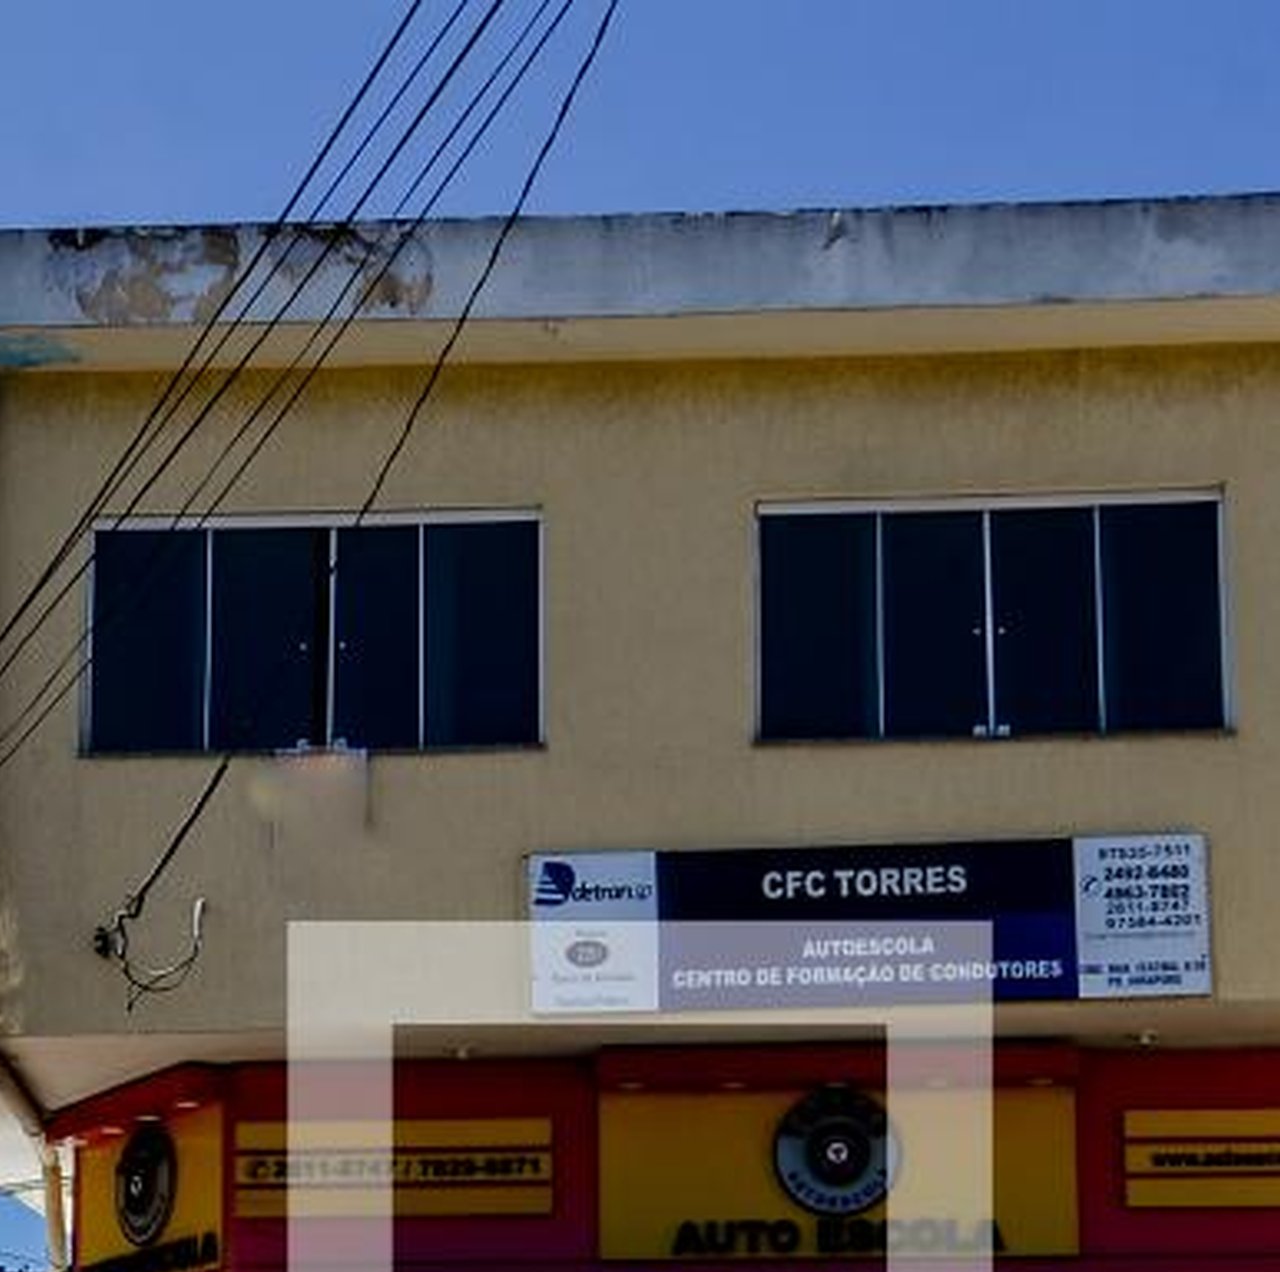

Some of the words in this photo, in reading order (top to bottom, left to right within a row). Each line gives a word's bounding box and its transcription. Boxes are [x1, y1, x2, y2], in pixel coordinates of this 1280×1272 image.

[762, 870, 826, 899] CFC
[833, 865, 968, 897] TORRES
[802, 936, 935, 959] AUTOESCOLA
[673, 968, 751, 989] CENTRO
[756, 966, 781, 986] DE
[786, 961, 894, 988] FORMAÇÃO
[899, 963, 923, 982] DE
[929, 960, 1063, 981] CONDUTORES
[672, 1220, 801, 1254] AUTO
[817, 1219, 1006, 1254] ESCOLA
